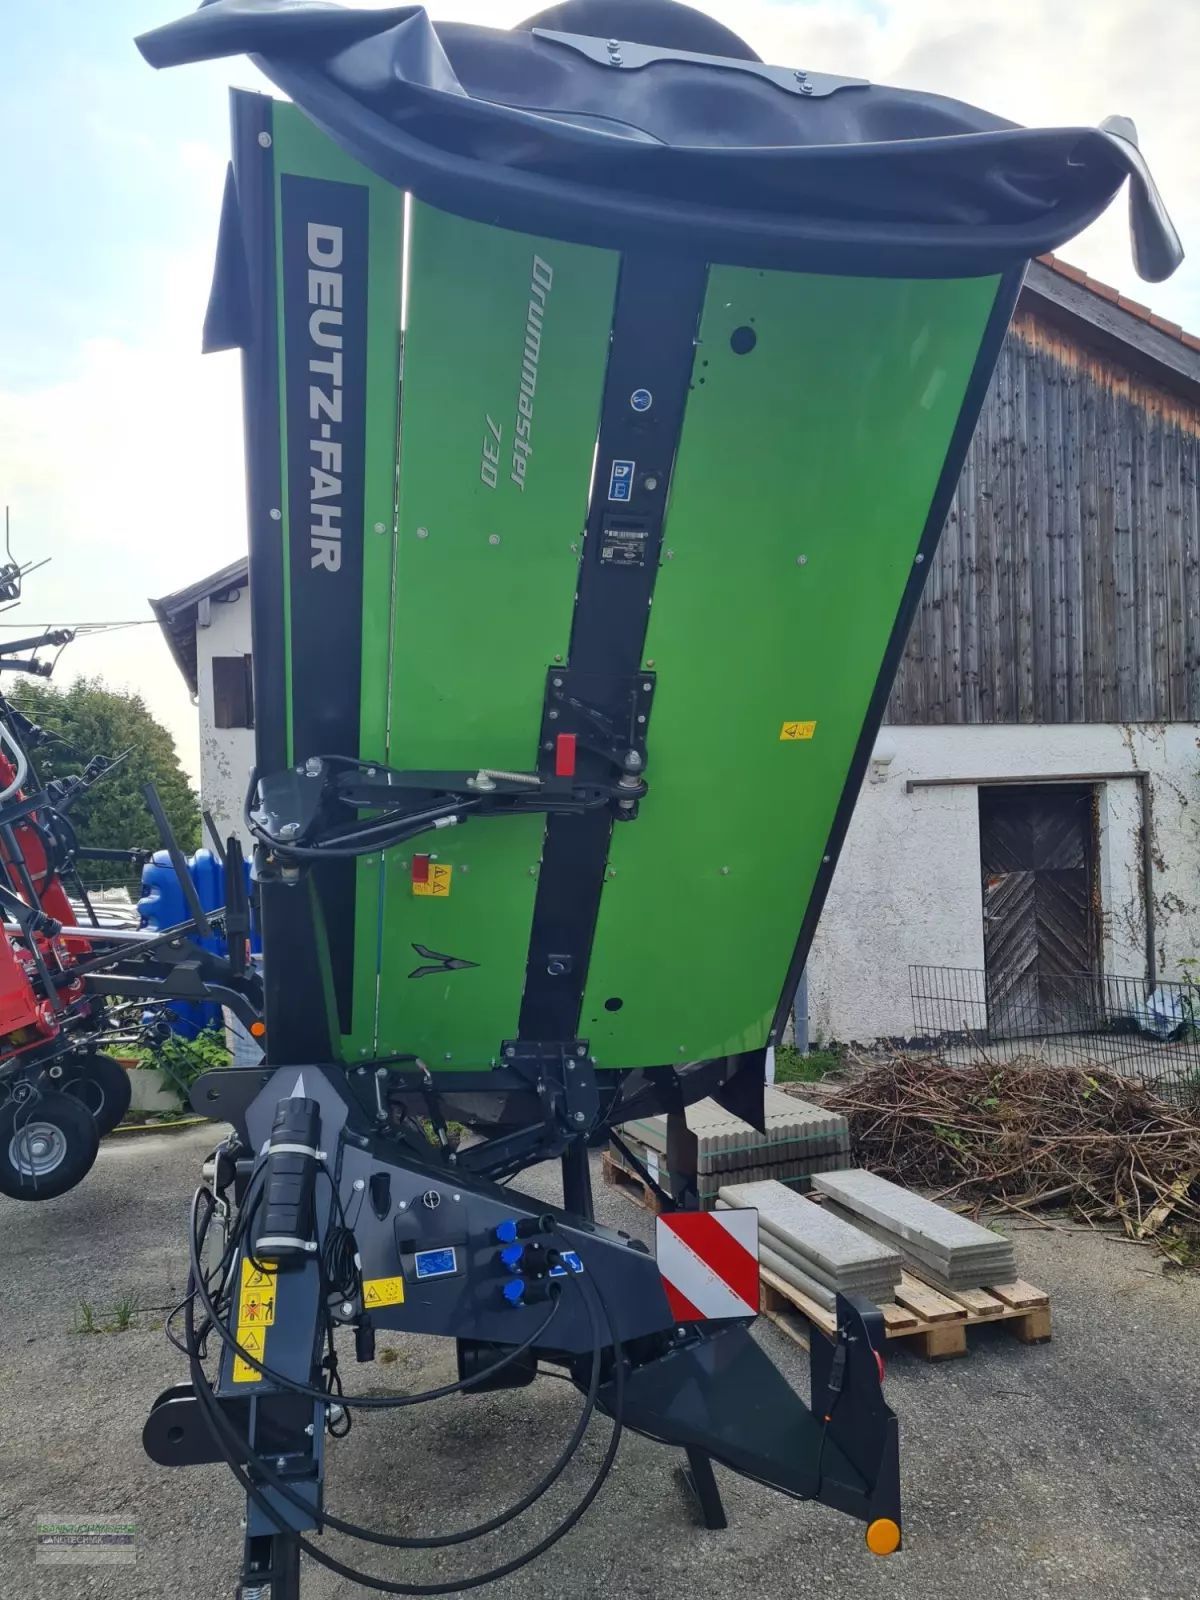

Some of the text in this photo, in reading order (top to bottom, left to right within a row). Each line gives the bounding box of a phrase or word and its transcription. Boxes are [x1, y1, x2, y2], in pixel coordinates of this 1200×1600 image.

[307, 221, 344, 573] DEUTZ-FAHR
[480, 412, 503, 489] 730
[510, 253, 554, 492] Drummaster
